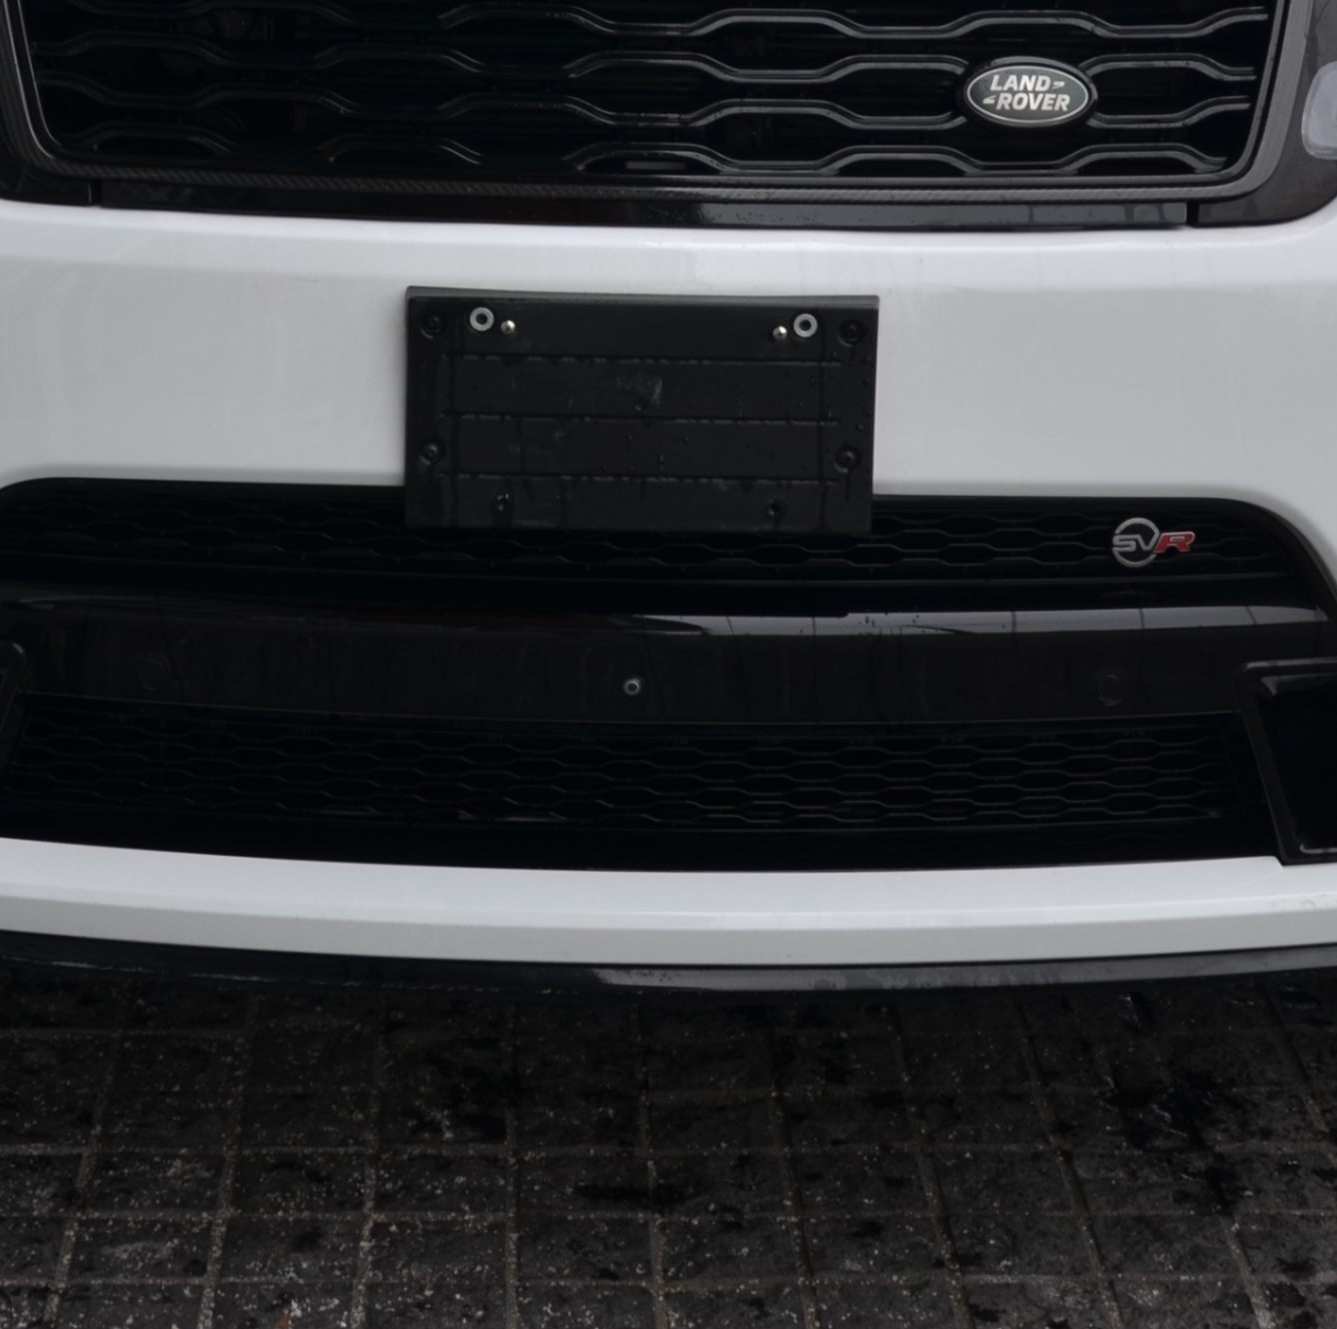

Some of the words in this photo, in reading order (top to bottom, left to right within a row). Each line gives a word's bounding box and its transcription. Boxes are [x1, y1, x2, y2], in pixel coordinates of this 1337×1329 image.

[990, 74, 1051, 92] LAND
[995, 92, 1071, 112] ROVER
[1111, 516, 1196, 569] SVR
